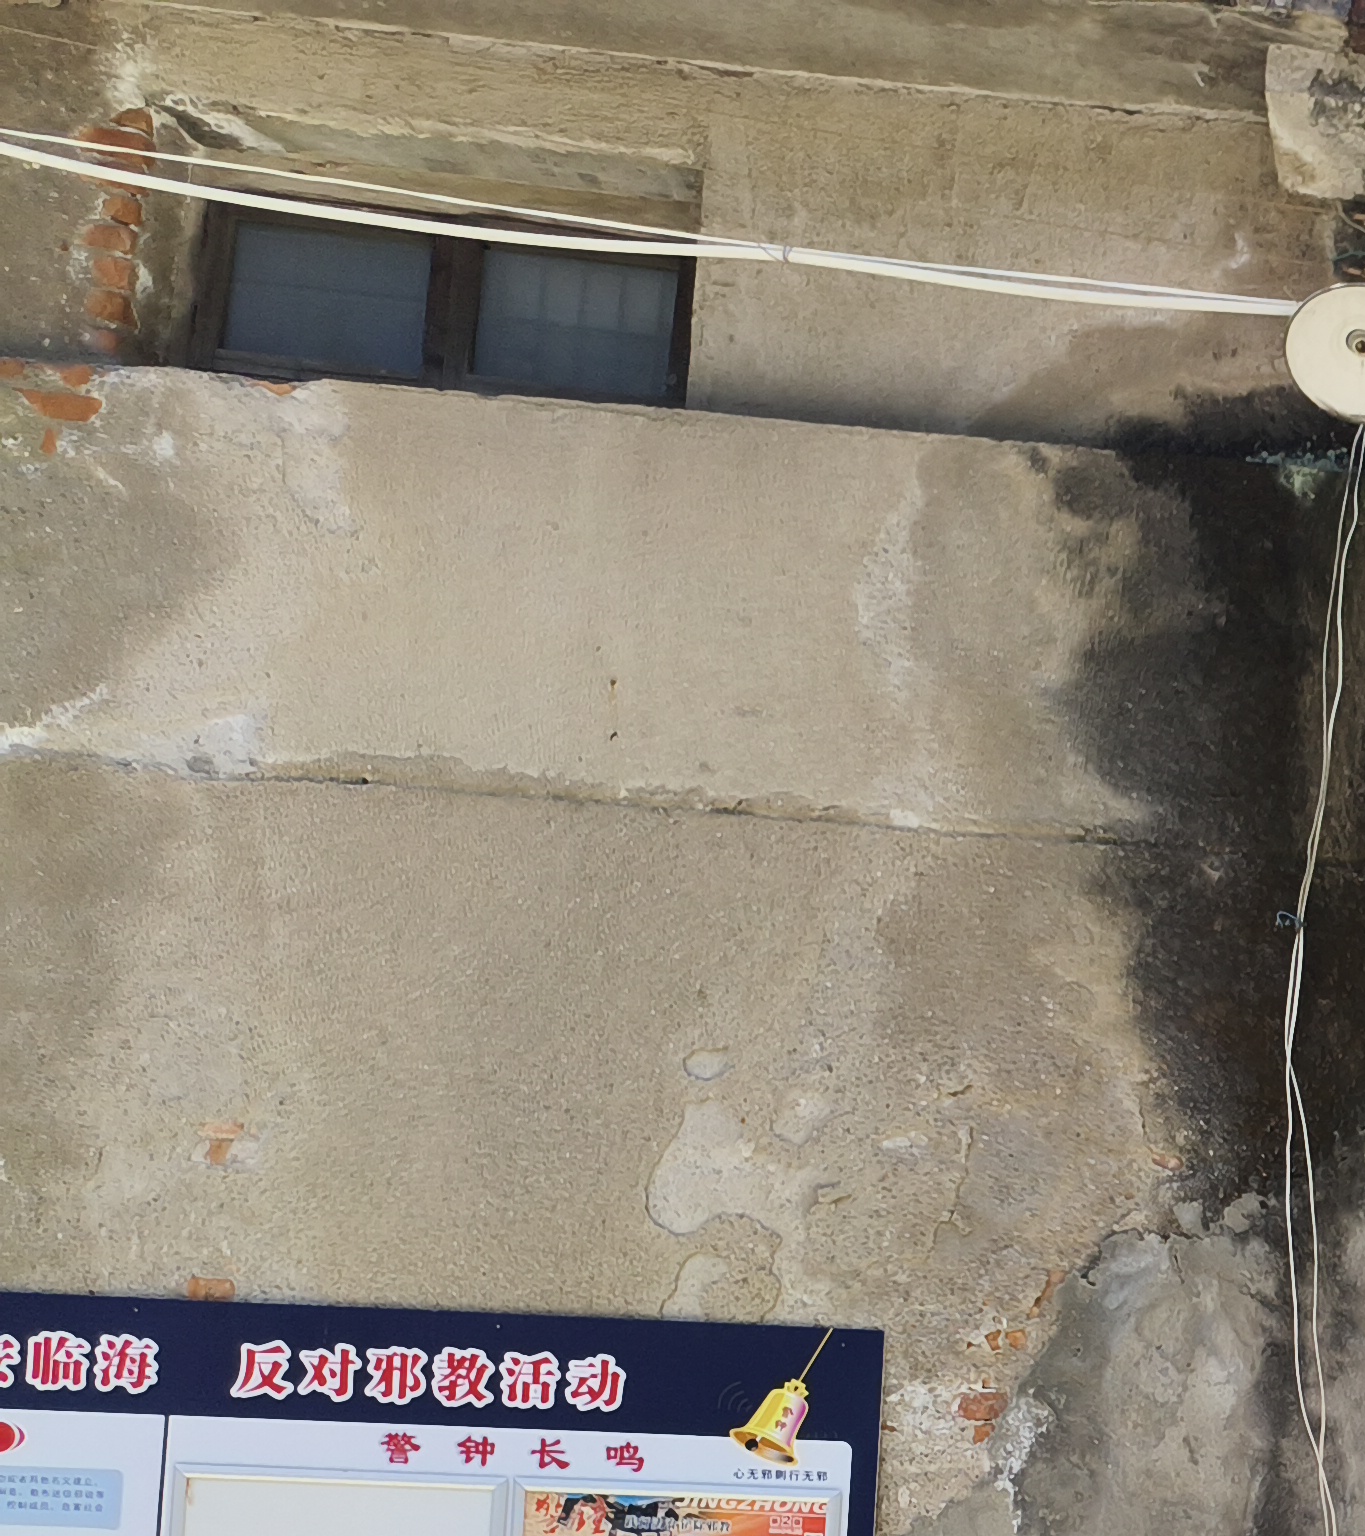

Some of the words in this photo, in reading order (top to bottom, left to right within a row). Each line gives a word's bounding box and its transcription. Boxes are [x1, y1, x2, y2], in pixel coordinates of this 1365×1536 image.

[230, 1340, 626, 1412] 反对邪教活动
[381, 1432, 645, 1472] 警钟长鸣
[733, 1468, 828, 1481] 心无邪则行无邪
